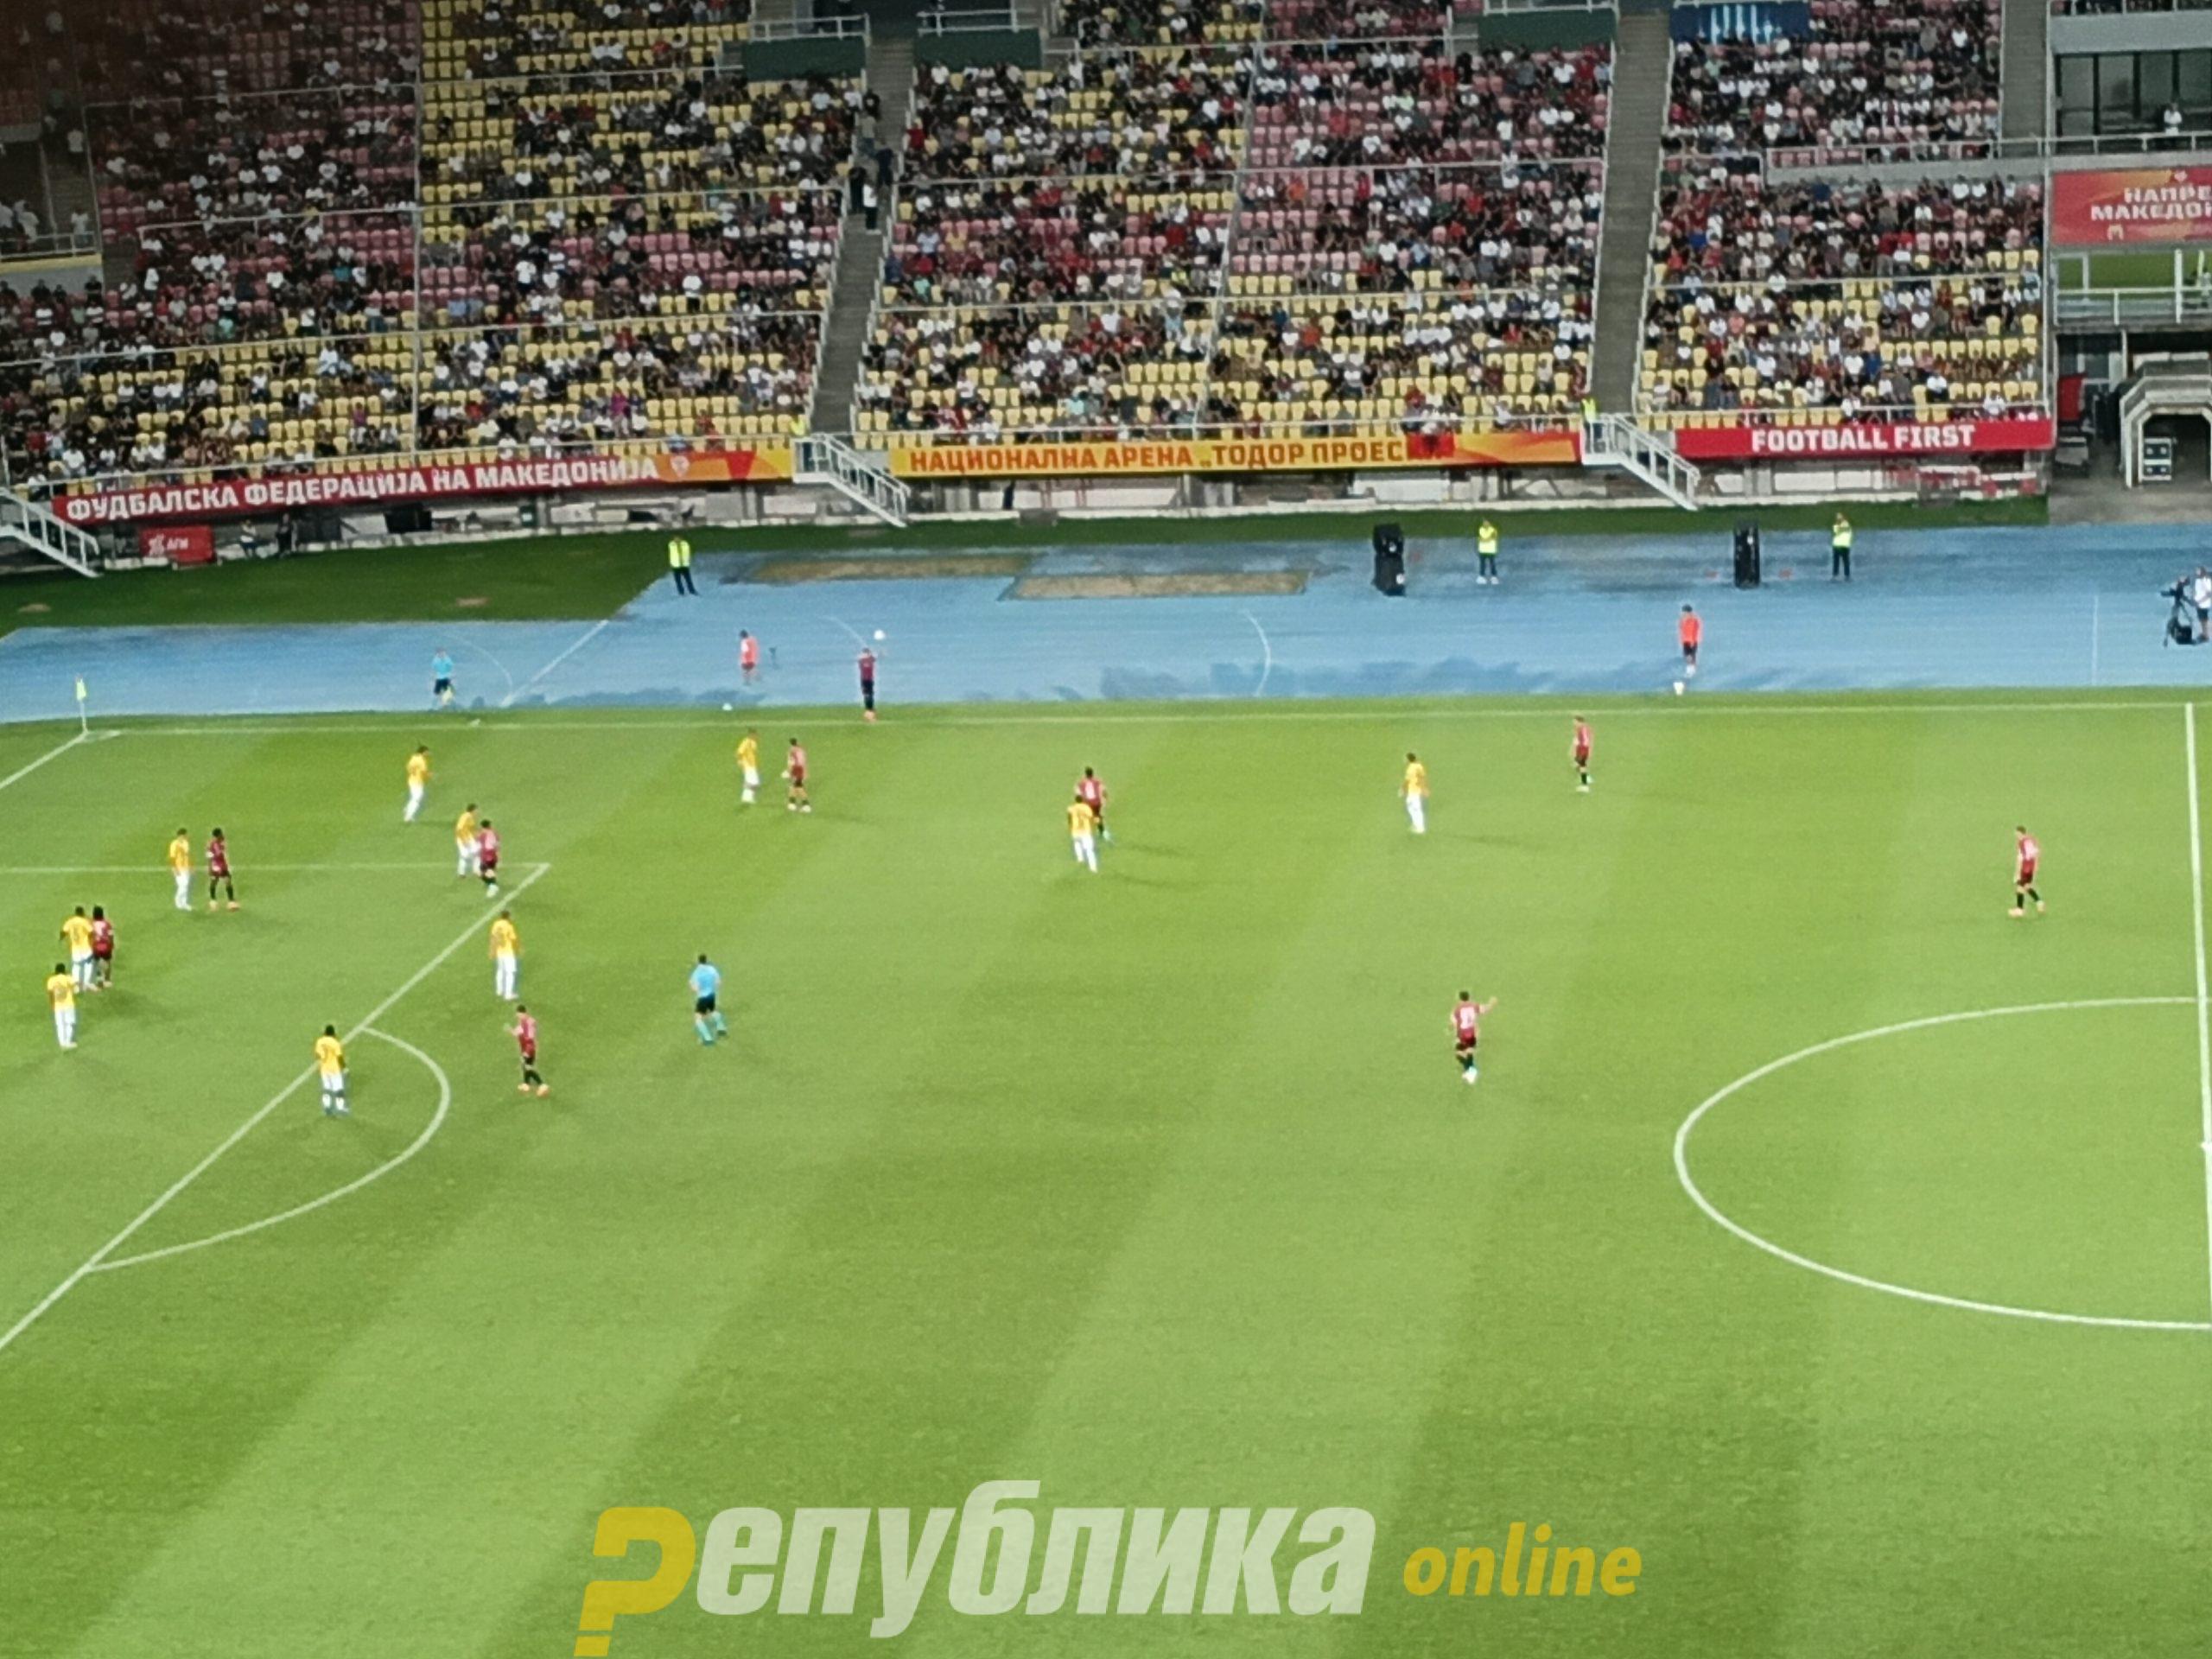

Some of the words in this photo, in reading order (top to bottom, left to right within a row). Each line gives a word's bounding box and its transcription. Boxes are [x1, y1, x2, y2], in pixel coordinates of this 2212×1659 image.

[1751, 427, 1889, 453] FOOTBALL
[1894, 423, 1976, 448] FIRST
[909, 447, 1097, 474] НАЦИОНАЛНА
[1103, 445, 1193, 468] АРЕНА
[1311, 440, 1407, 465] ПРОЕС
[66, 483, 239, 521] ФУДБАЛСКА
[245, 470, 427, 505] ФЕДЕРАЦИЈА
[431, 466, 471, 492] НА
[475, 458, 658, 489] МАКЕДОНИЈА
